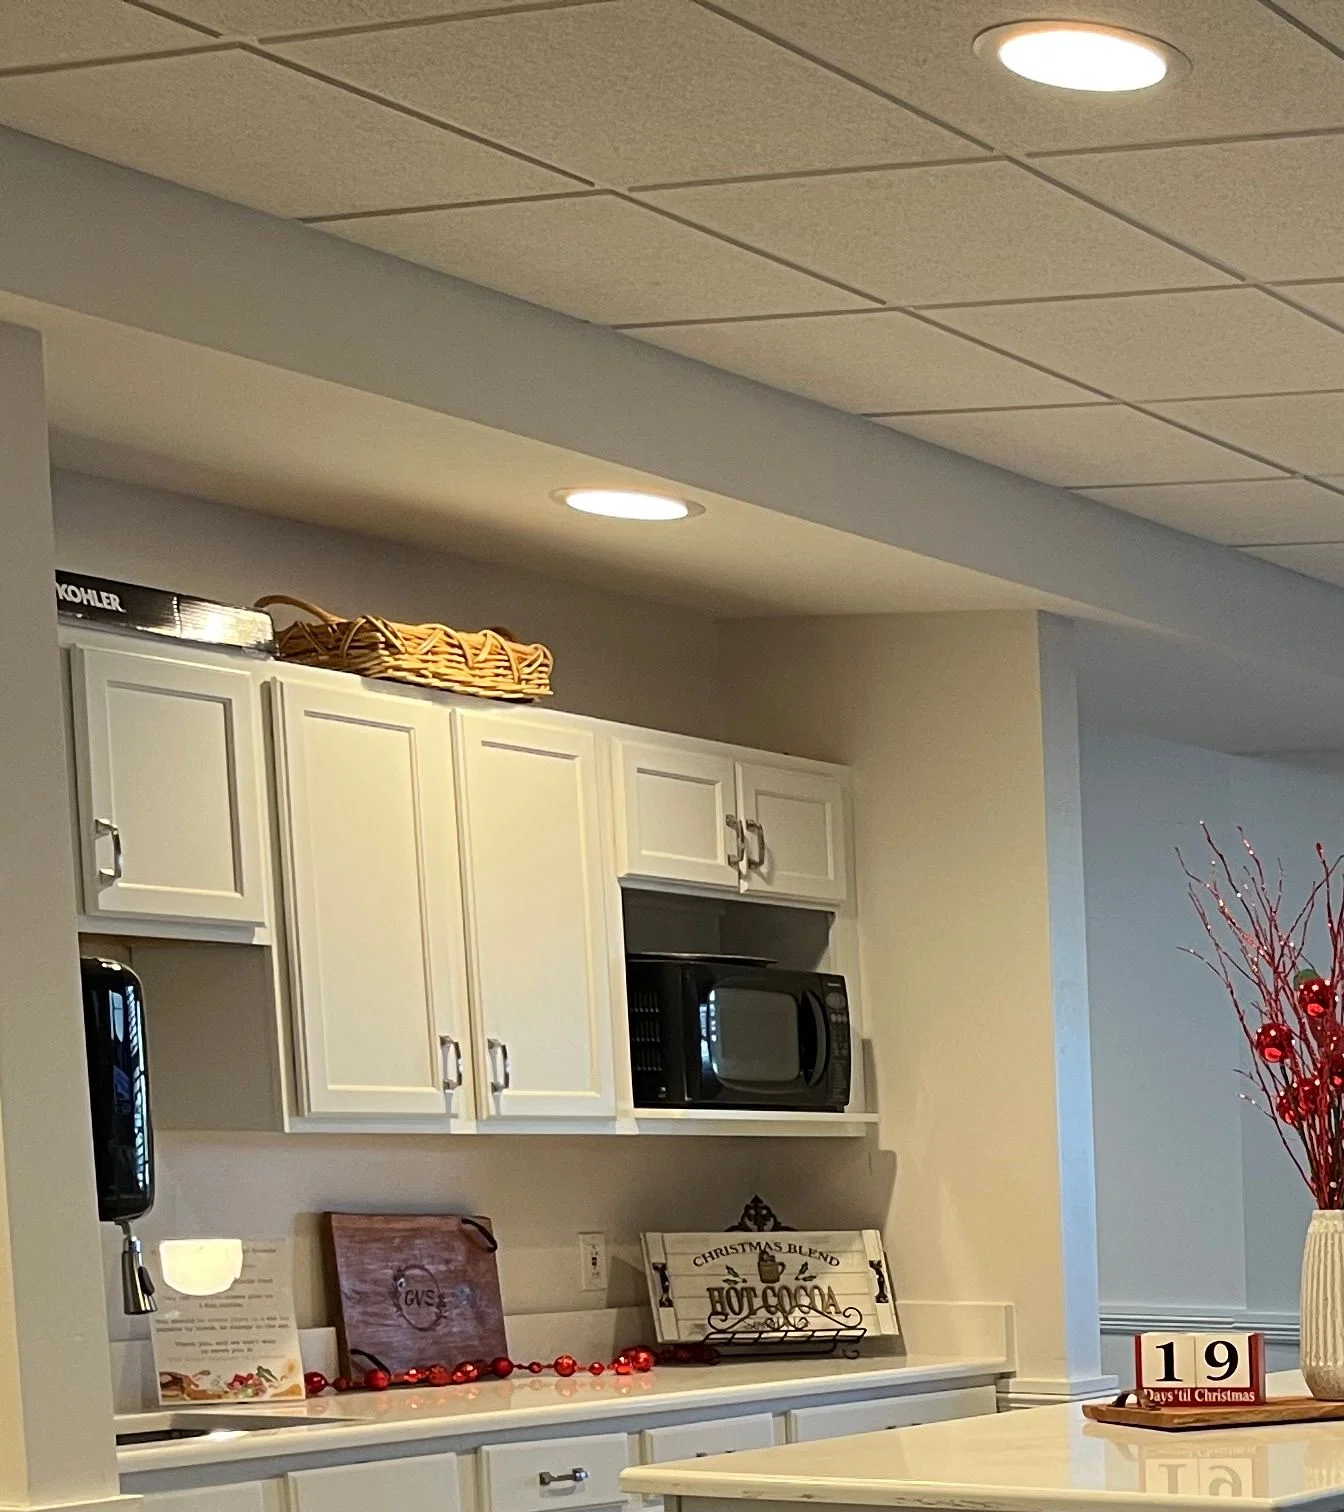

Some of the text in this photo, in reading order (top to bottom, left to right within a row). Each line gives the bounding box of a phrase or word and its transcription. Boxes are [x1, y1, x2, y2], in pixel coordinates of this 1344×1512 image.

[56, 582, 127, 613] KOHLER
[692, 1241, 840, 1267] CHRISTMAS BLEND
[706, 1284, 842, 1316] HOT COCOA
[1143, 1388, 1173, 1404] Days
[1194, 1388, 1255, 1402] Christmas
